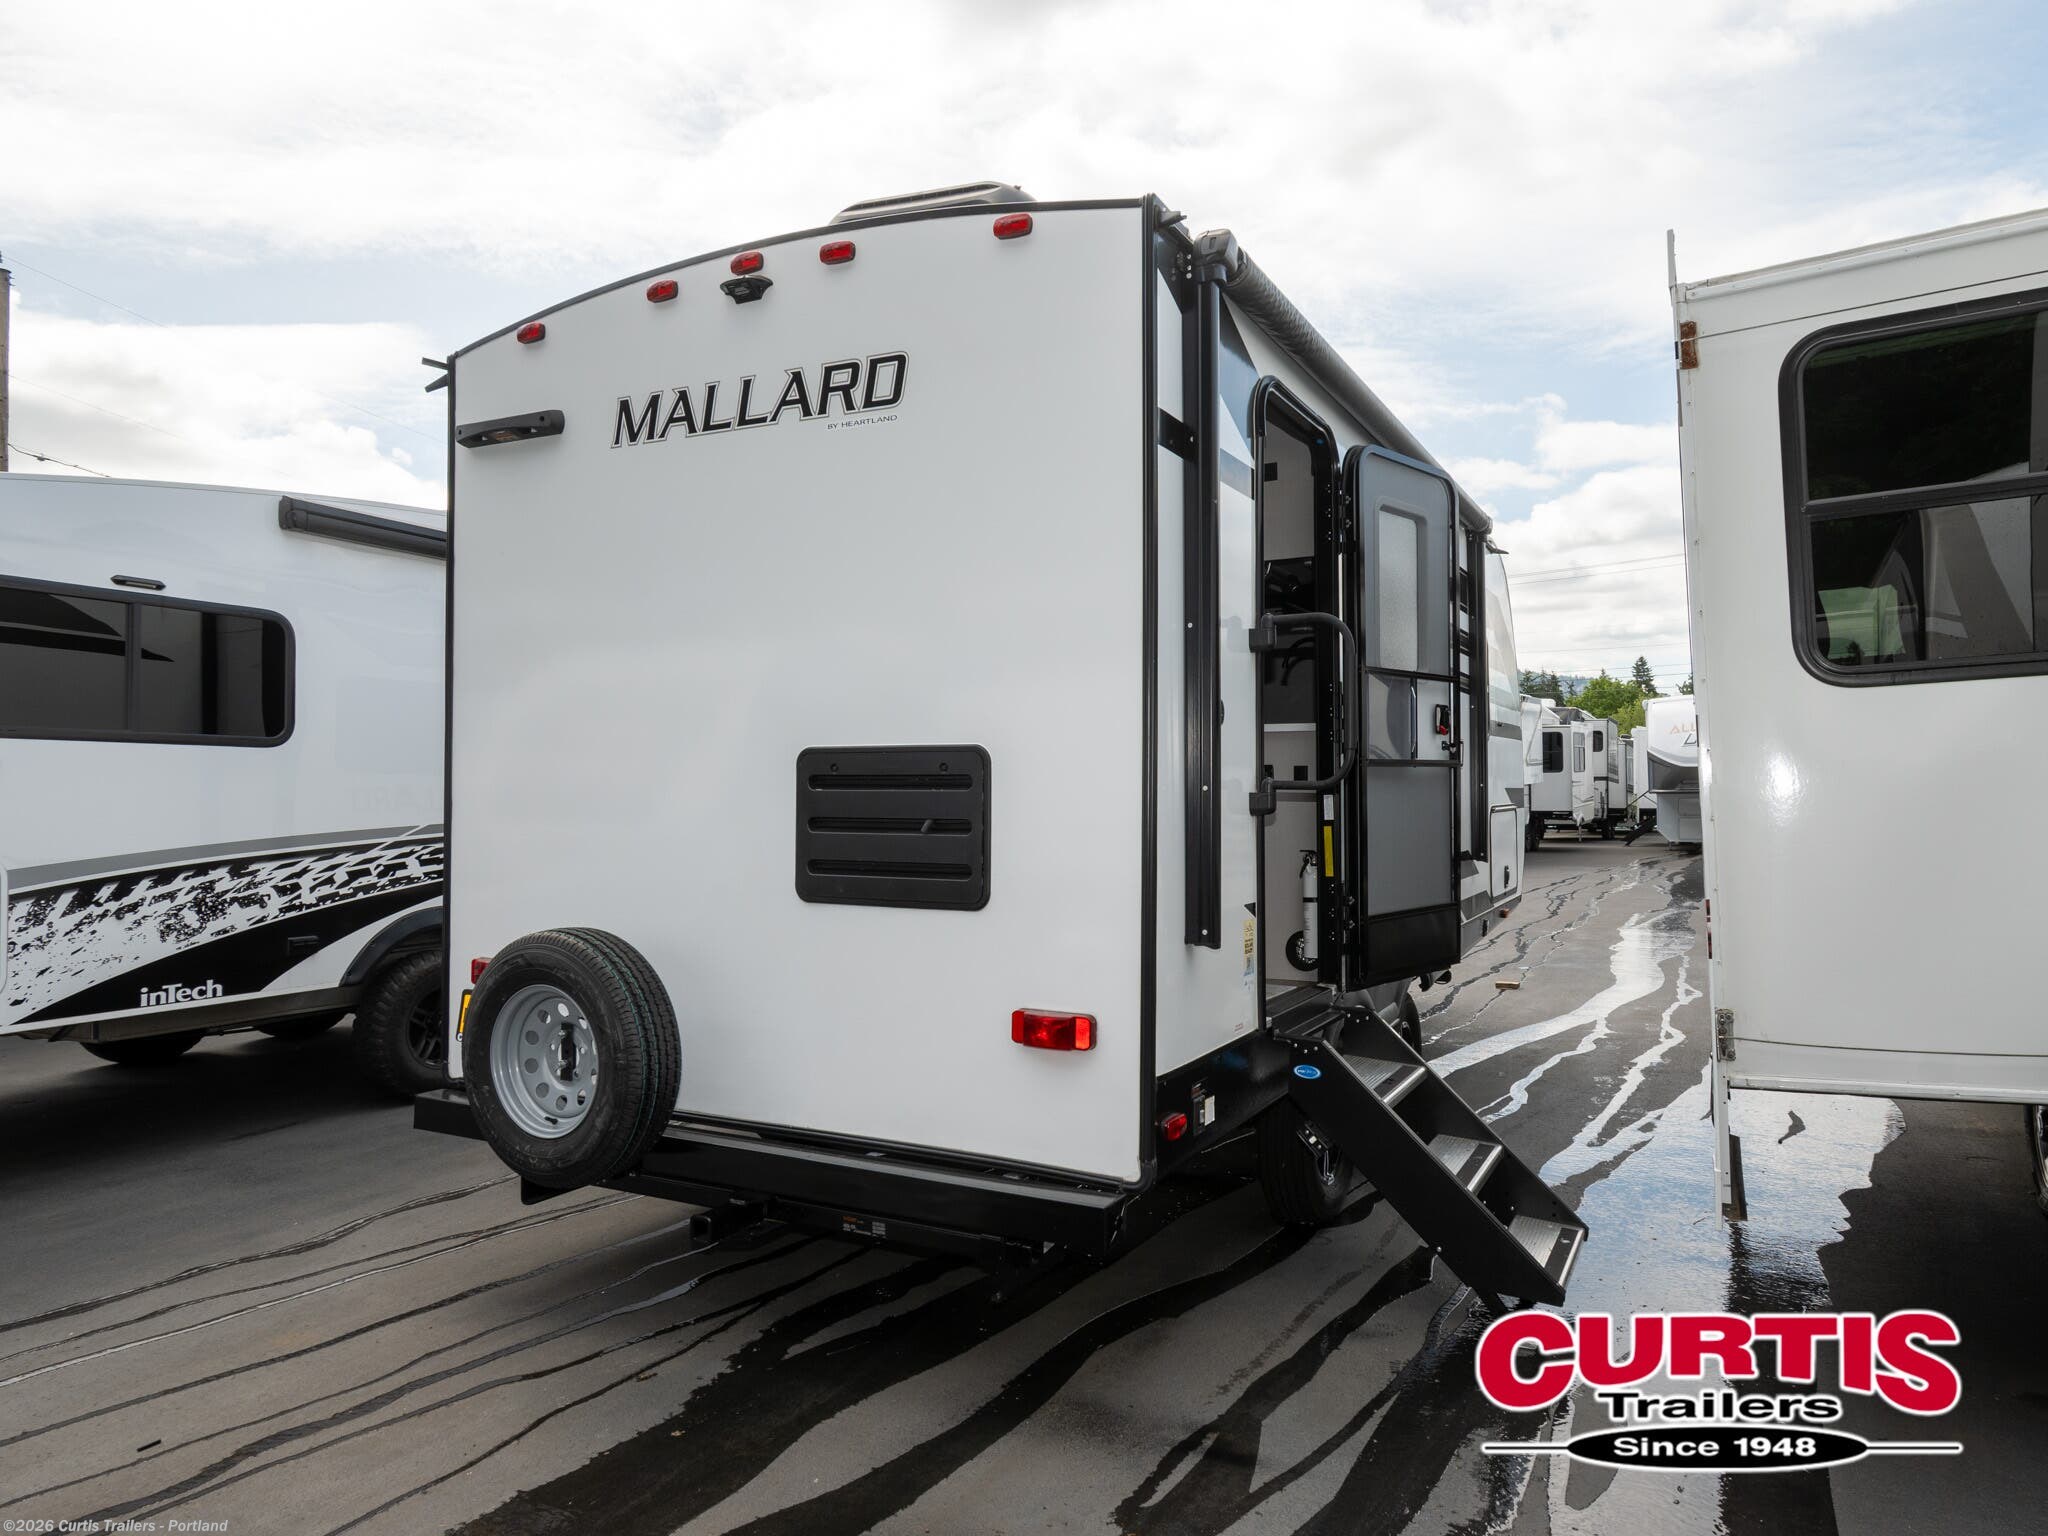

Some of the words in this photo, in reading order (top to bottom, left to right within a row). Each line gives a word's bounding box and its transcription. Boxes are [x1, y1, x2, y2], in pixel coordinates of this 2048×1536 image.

[611, 351, 909, 448] MALLARD
[841, 414, 898, 428] HEARTLAND
[140, 979, 223, 1007] inTech
